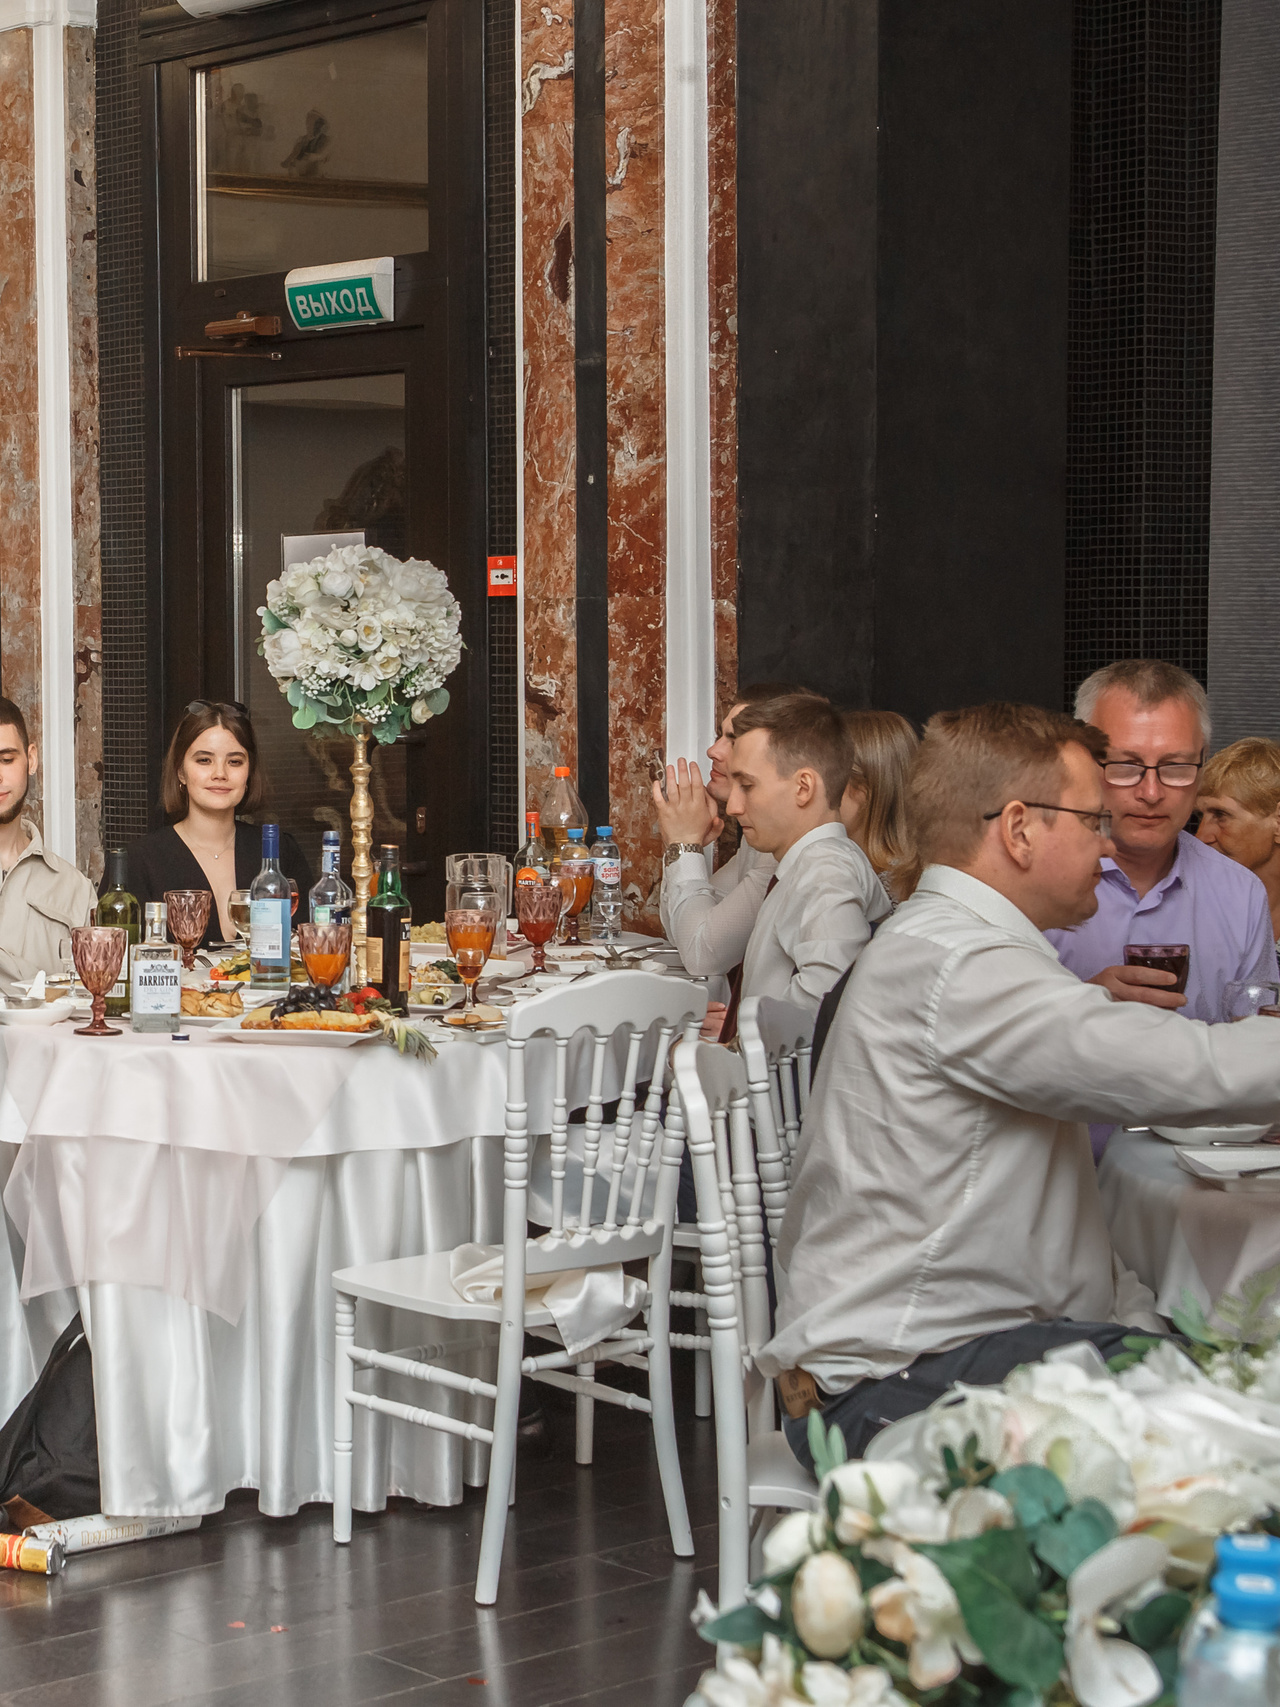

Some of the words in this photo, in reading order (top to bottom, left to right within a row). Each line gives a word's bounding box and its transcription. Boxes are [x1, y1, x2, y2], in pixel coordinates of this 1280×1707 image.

[295, 287, 376, 319] ВЫХОД
[138, 975, 179, 986] BARRISTER
[81, 1523, 143, 1546] Поздравляю
